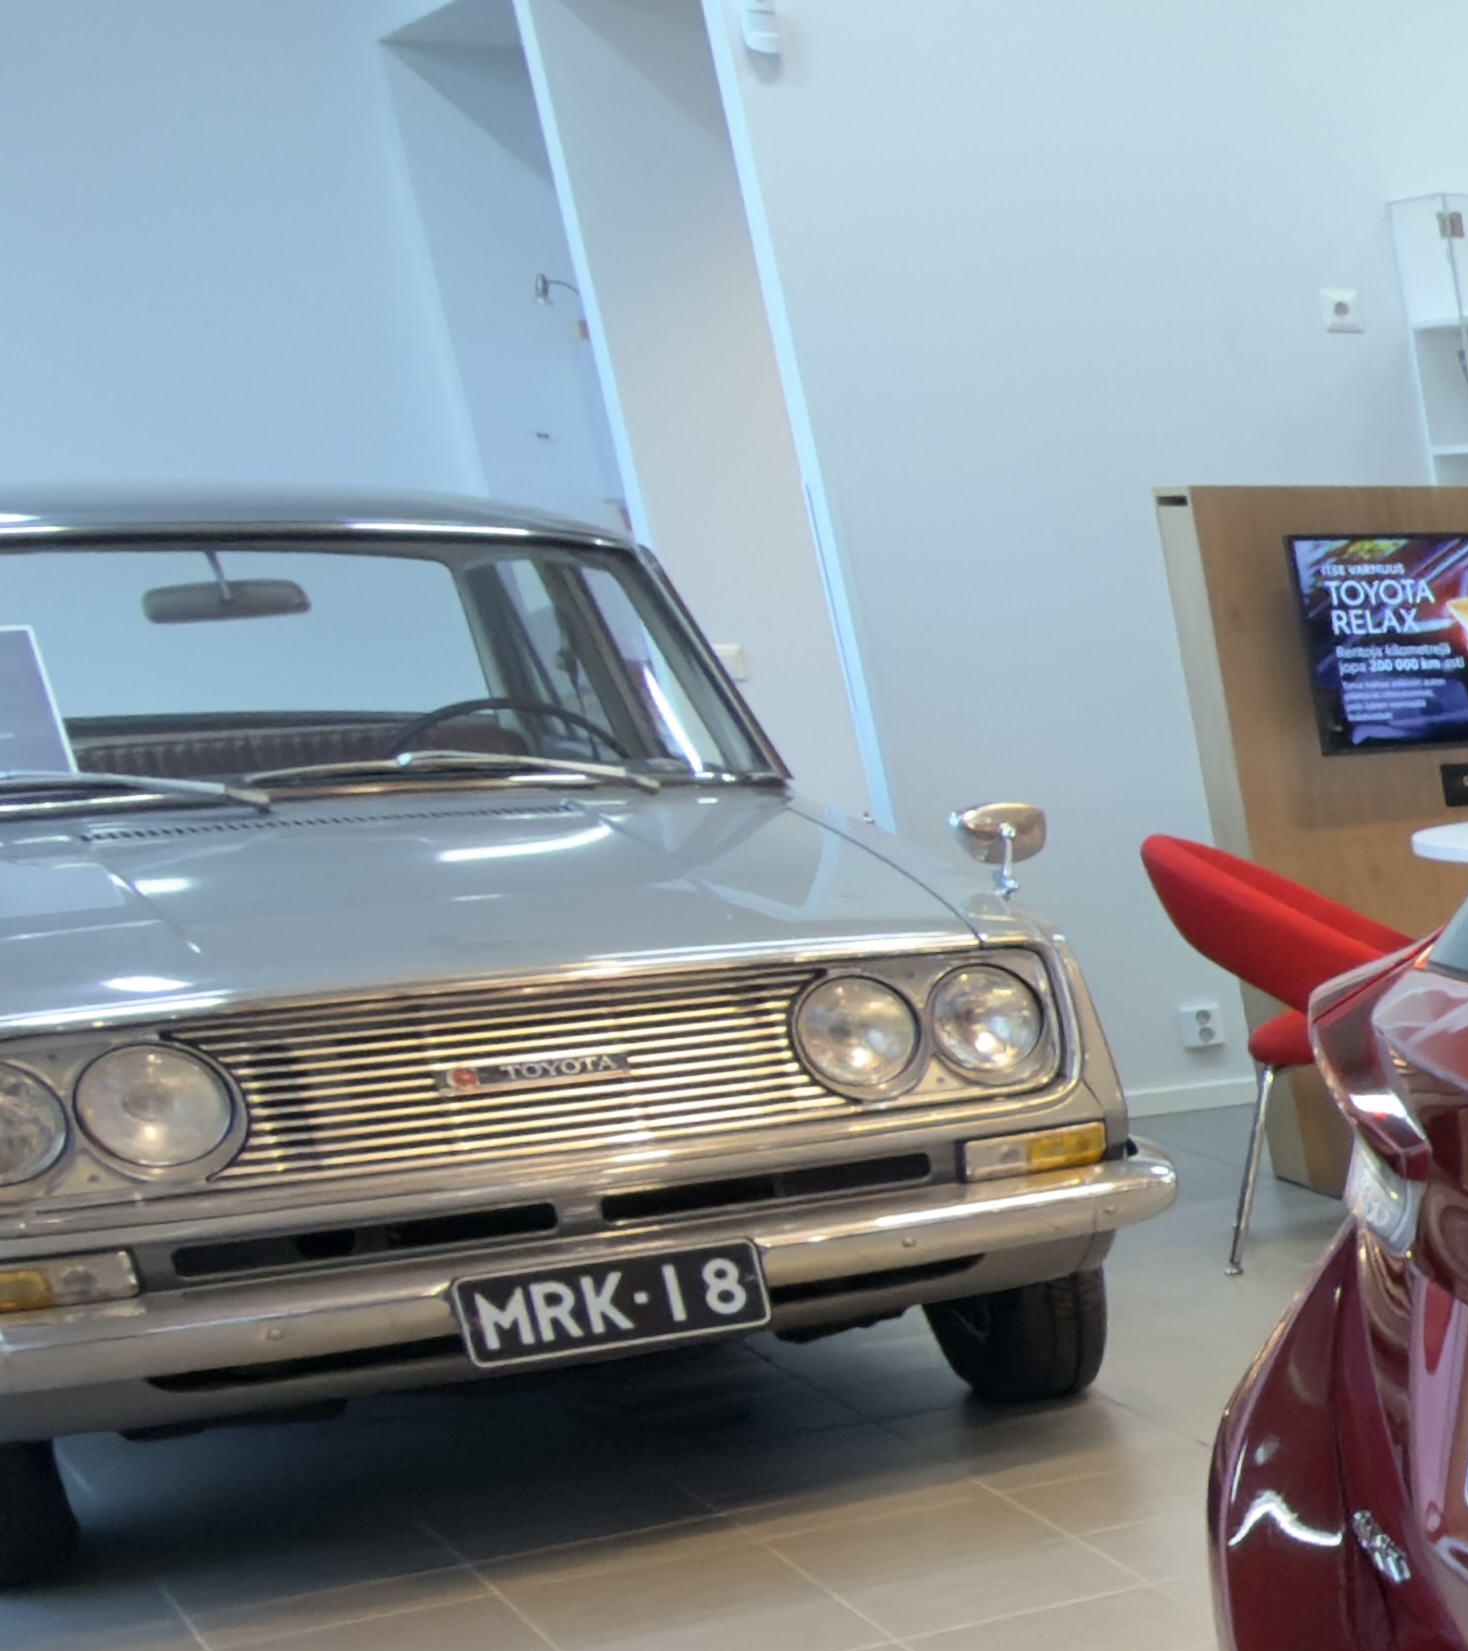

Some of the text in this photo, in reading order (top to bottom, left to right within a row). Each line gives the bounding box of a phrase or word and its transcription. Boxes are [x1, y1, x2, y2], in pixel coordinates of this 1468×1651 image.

[1324, 578, 1436, 607] TOYOTA
[1331, 607, 1420, 635] RELAX
[1369, 658, 1393, 672] 200
[1395, 658, 1419, 672] 000
[1421, 657, 1441, 670] km
[500, 1054, 618, 1080] TOYOTA
